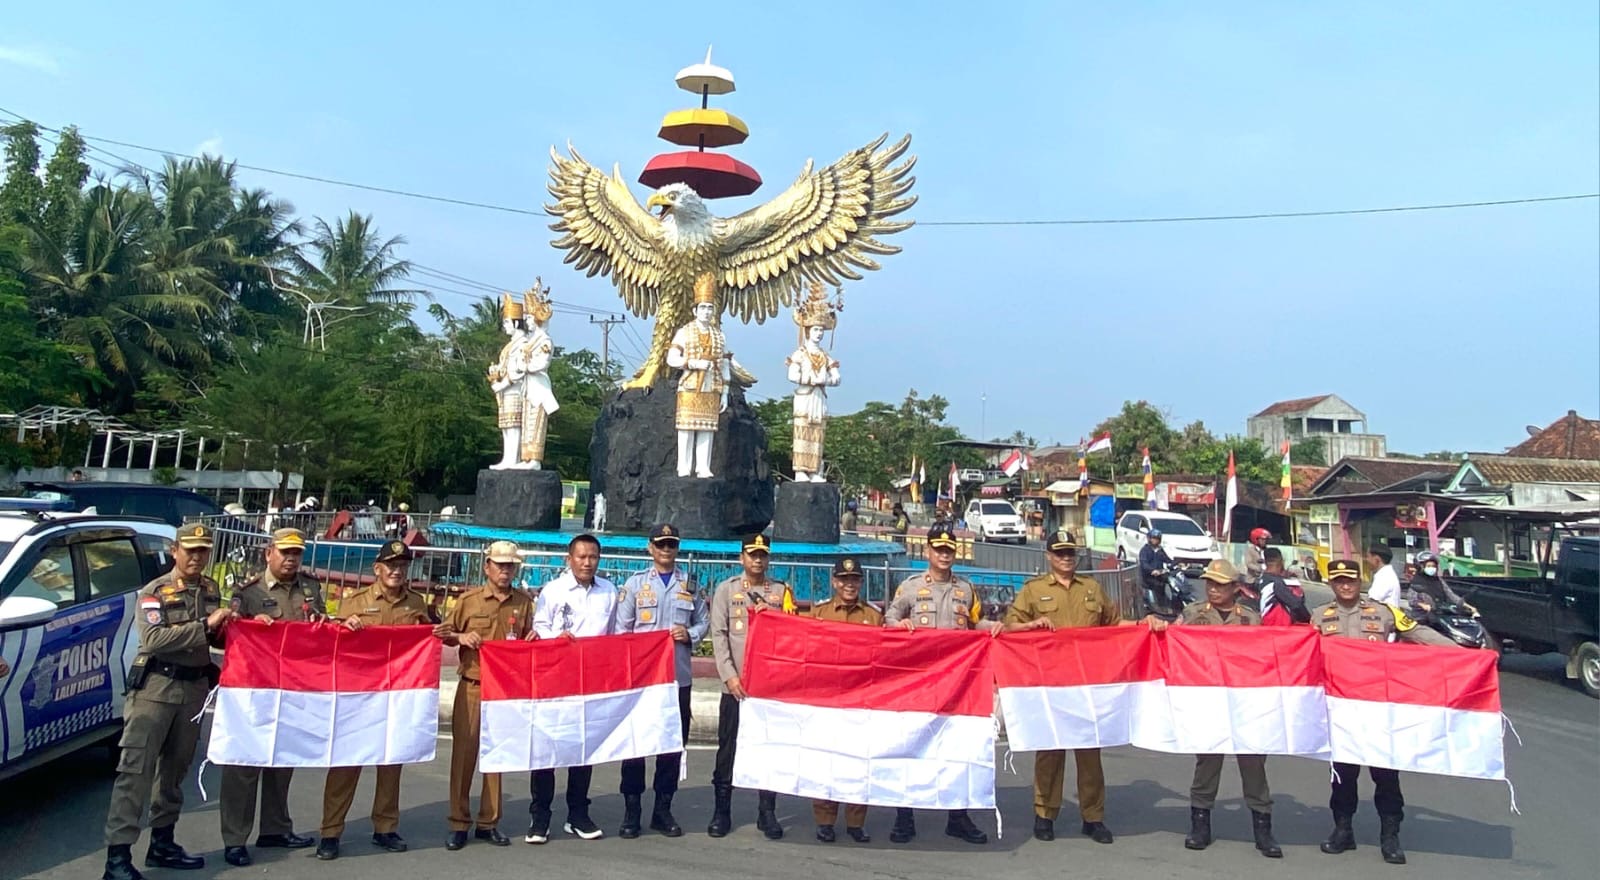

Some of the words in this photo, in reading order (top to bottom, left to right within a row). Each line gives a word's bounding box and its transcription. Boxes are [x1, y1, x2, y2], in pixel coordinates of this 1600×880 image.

[58, 637, 108, 681] POLISI
[54, 682, 77, 702] LALU
[77, 673, 106, 694] LINTAS
